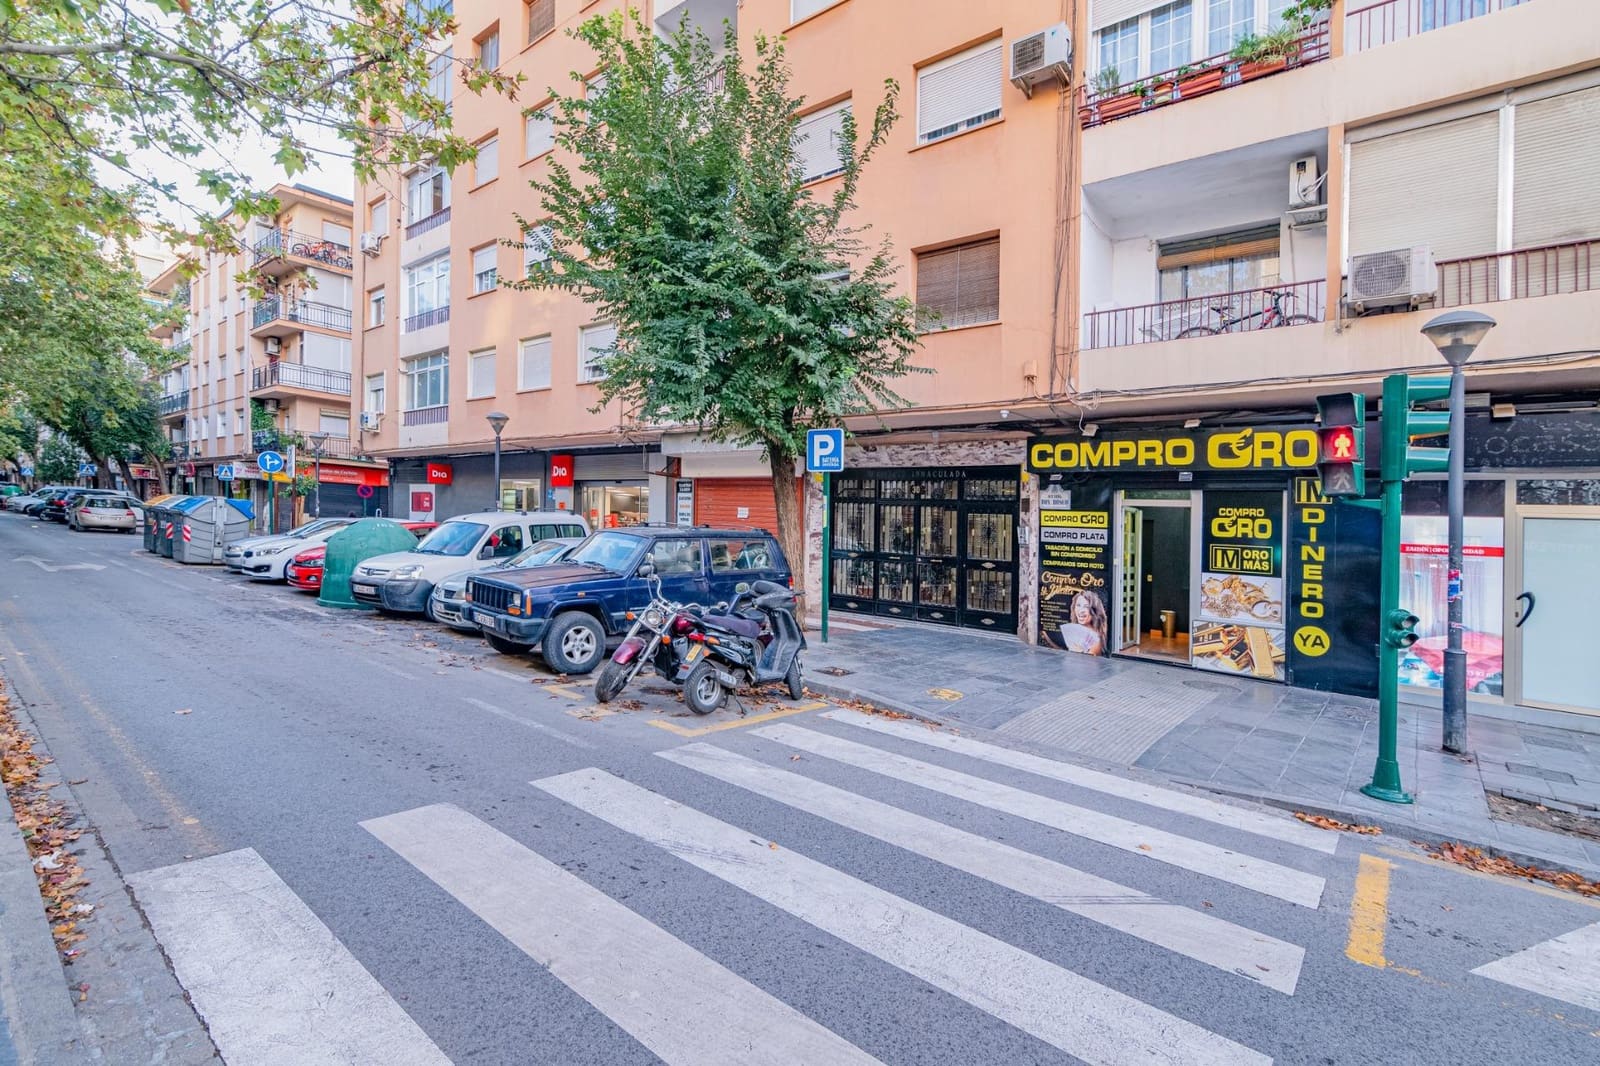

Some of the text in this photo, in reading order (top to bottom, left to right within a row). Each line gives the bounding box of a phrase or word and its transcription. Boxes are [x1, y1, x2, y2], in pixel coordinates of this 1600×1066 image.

[814, 434, 834, 466] P
[1031, 428, 1318, 468] COMPRO ORO
[1043, 514, 1105, 524] COMPRO ORO
[1218, 508, 1265, 517] COMPRO
[1212, 516, 1272, 539] ORO
[1043, 531, 1105, 540] COMPRO PLATA
[1243, 549, 1269, 560] ORO
[1243, 559, 1270, 571] MÁS
[1301, 508, 1325, 618] DINERO
[1042, 571, 1105, 587] Compro Oro
[1299, 633, 1326, 648] YA
